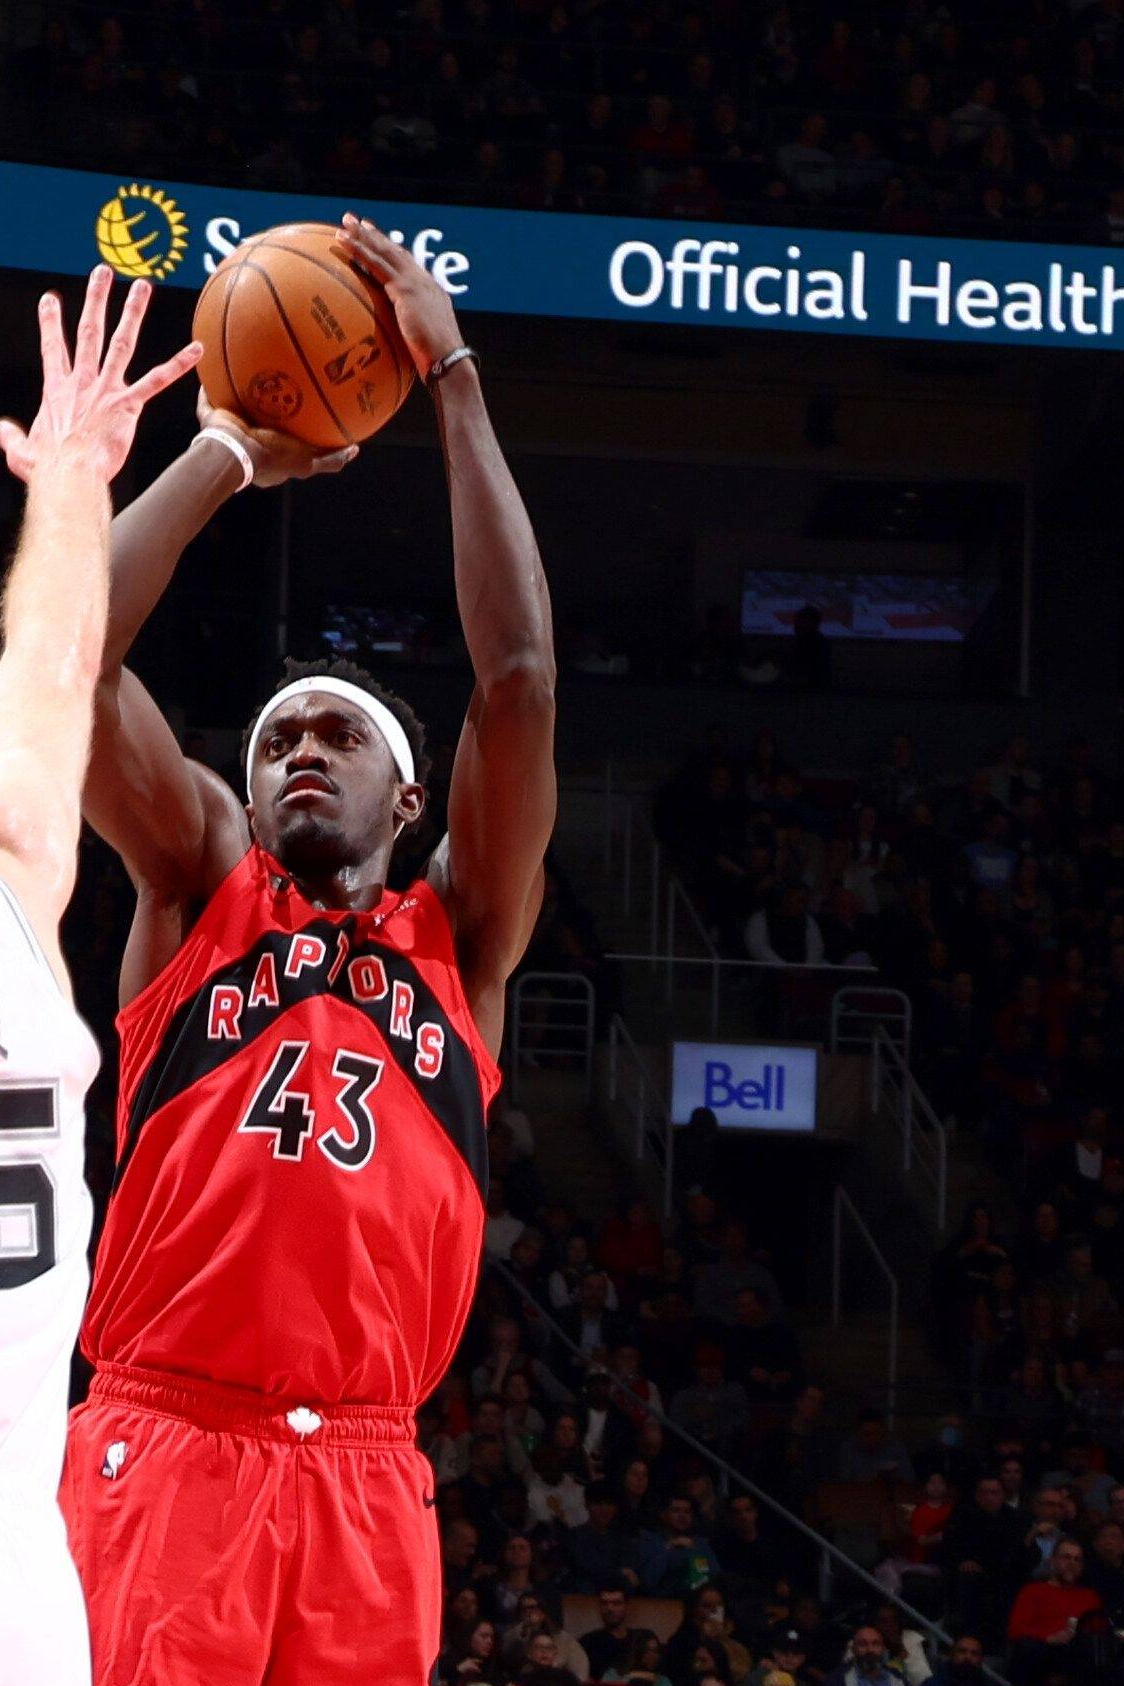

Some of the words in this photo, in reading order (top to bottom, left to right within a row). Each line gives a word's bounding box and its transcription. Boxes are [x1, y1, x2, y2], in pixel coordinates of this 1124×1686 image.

[609, 238, 868, 321] Official
[237, 1040, 385, 1172] 43
[704, 1060, 785, 1111] Bell
